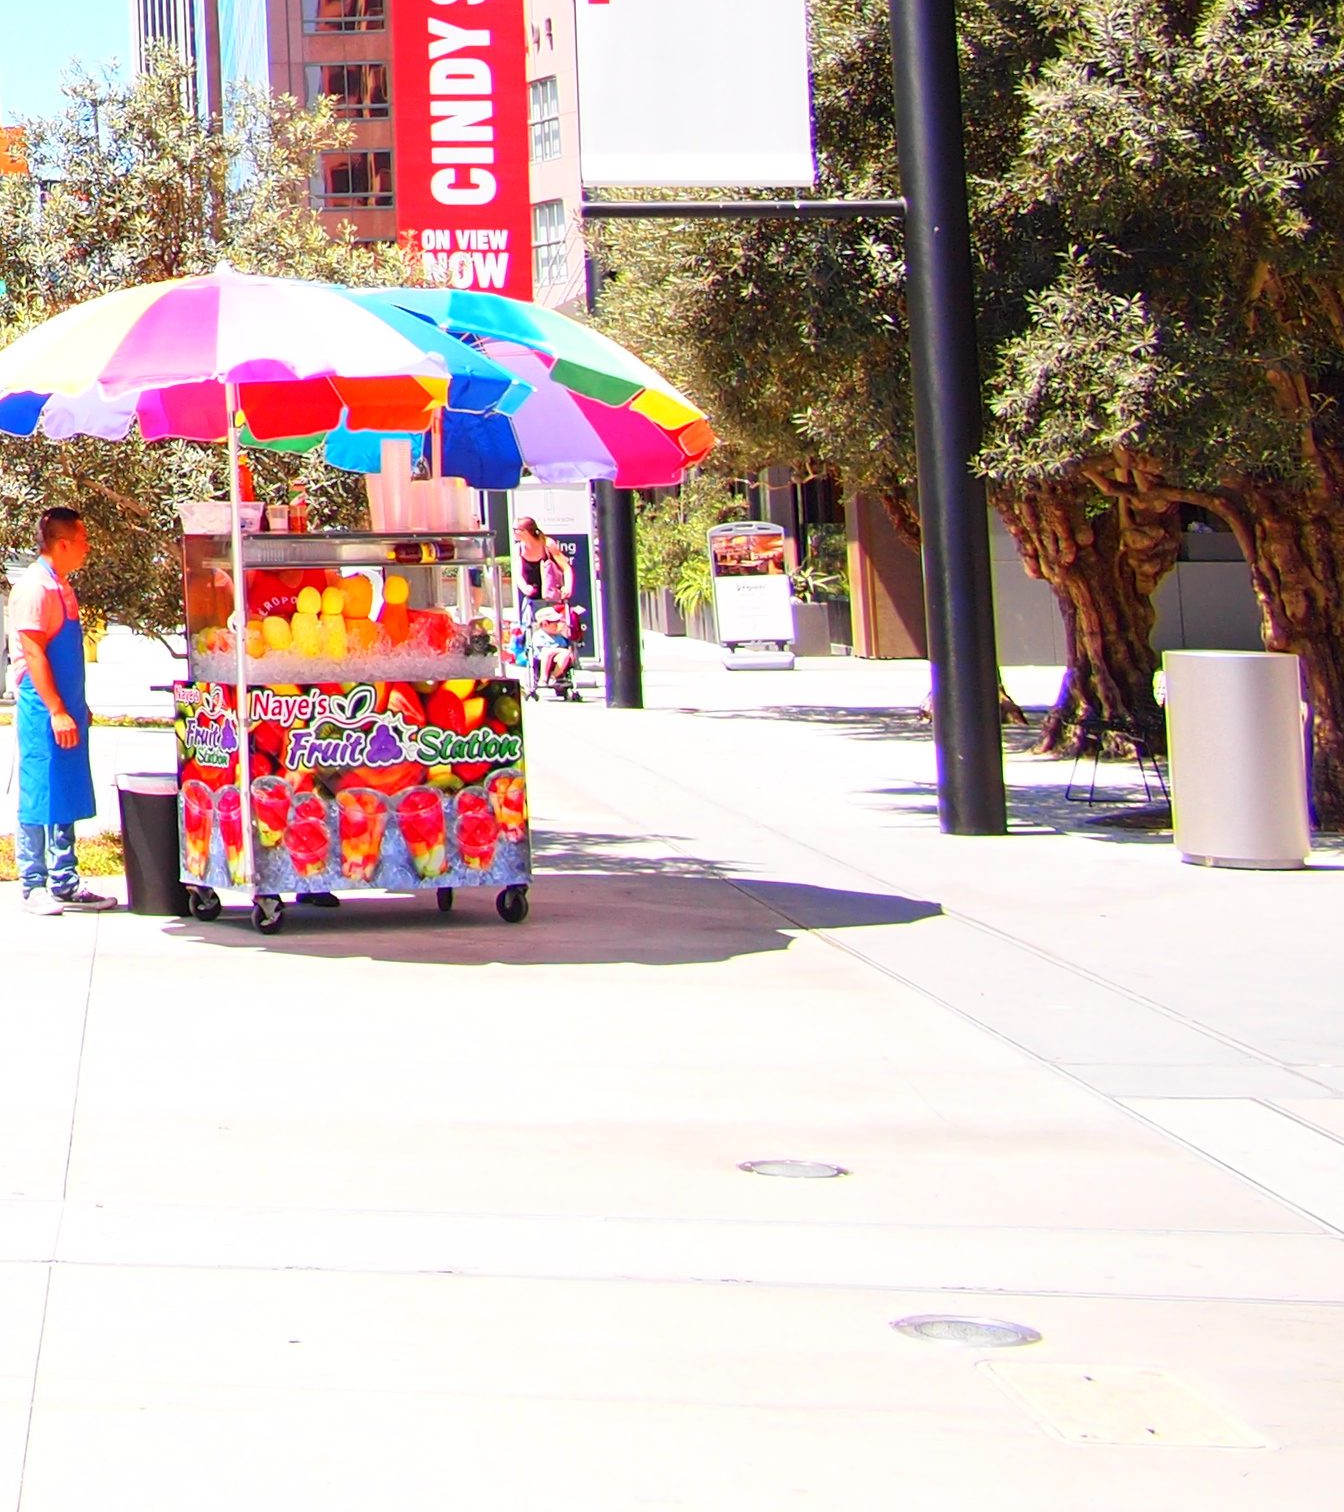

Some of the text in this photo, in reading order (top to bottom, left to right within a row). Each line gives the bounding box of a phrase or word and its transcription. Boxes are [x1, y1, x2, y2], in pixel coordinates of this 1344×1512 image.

[428, 18, 497, 206] CINDY
[421, 229, 508, 250] ON VIEW
[422, 251, 509, 289] NOW
[252, 689, 329, 726] Naye's
[186, 719, 220, 749] Fruit
[288, 726, 521, 768] Fruit Station
